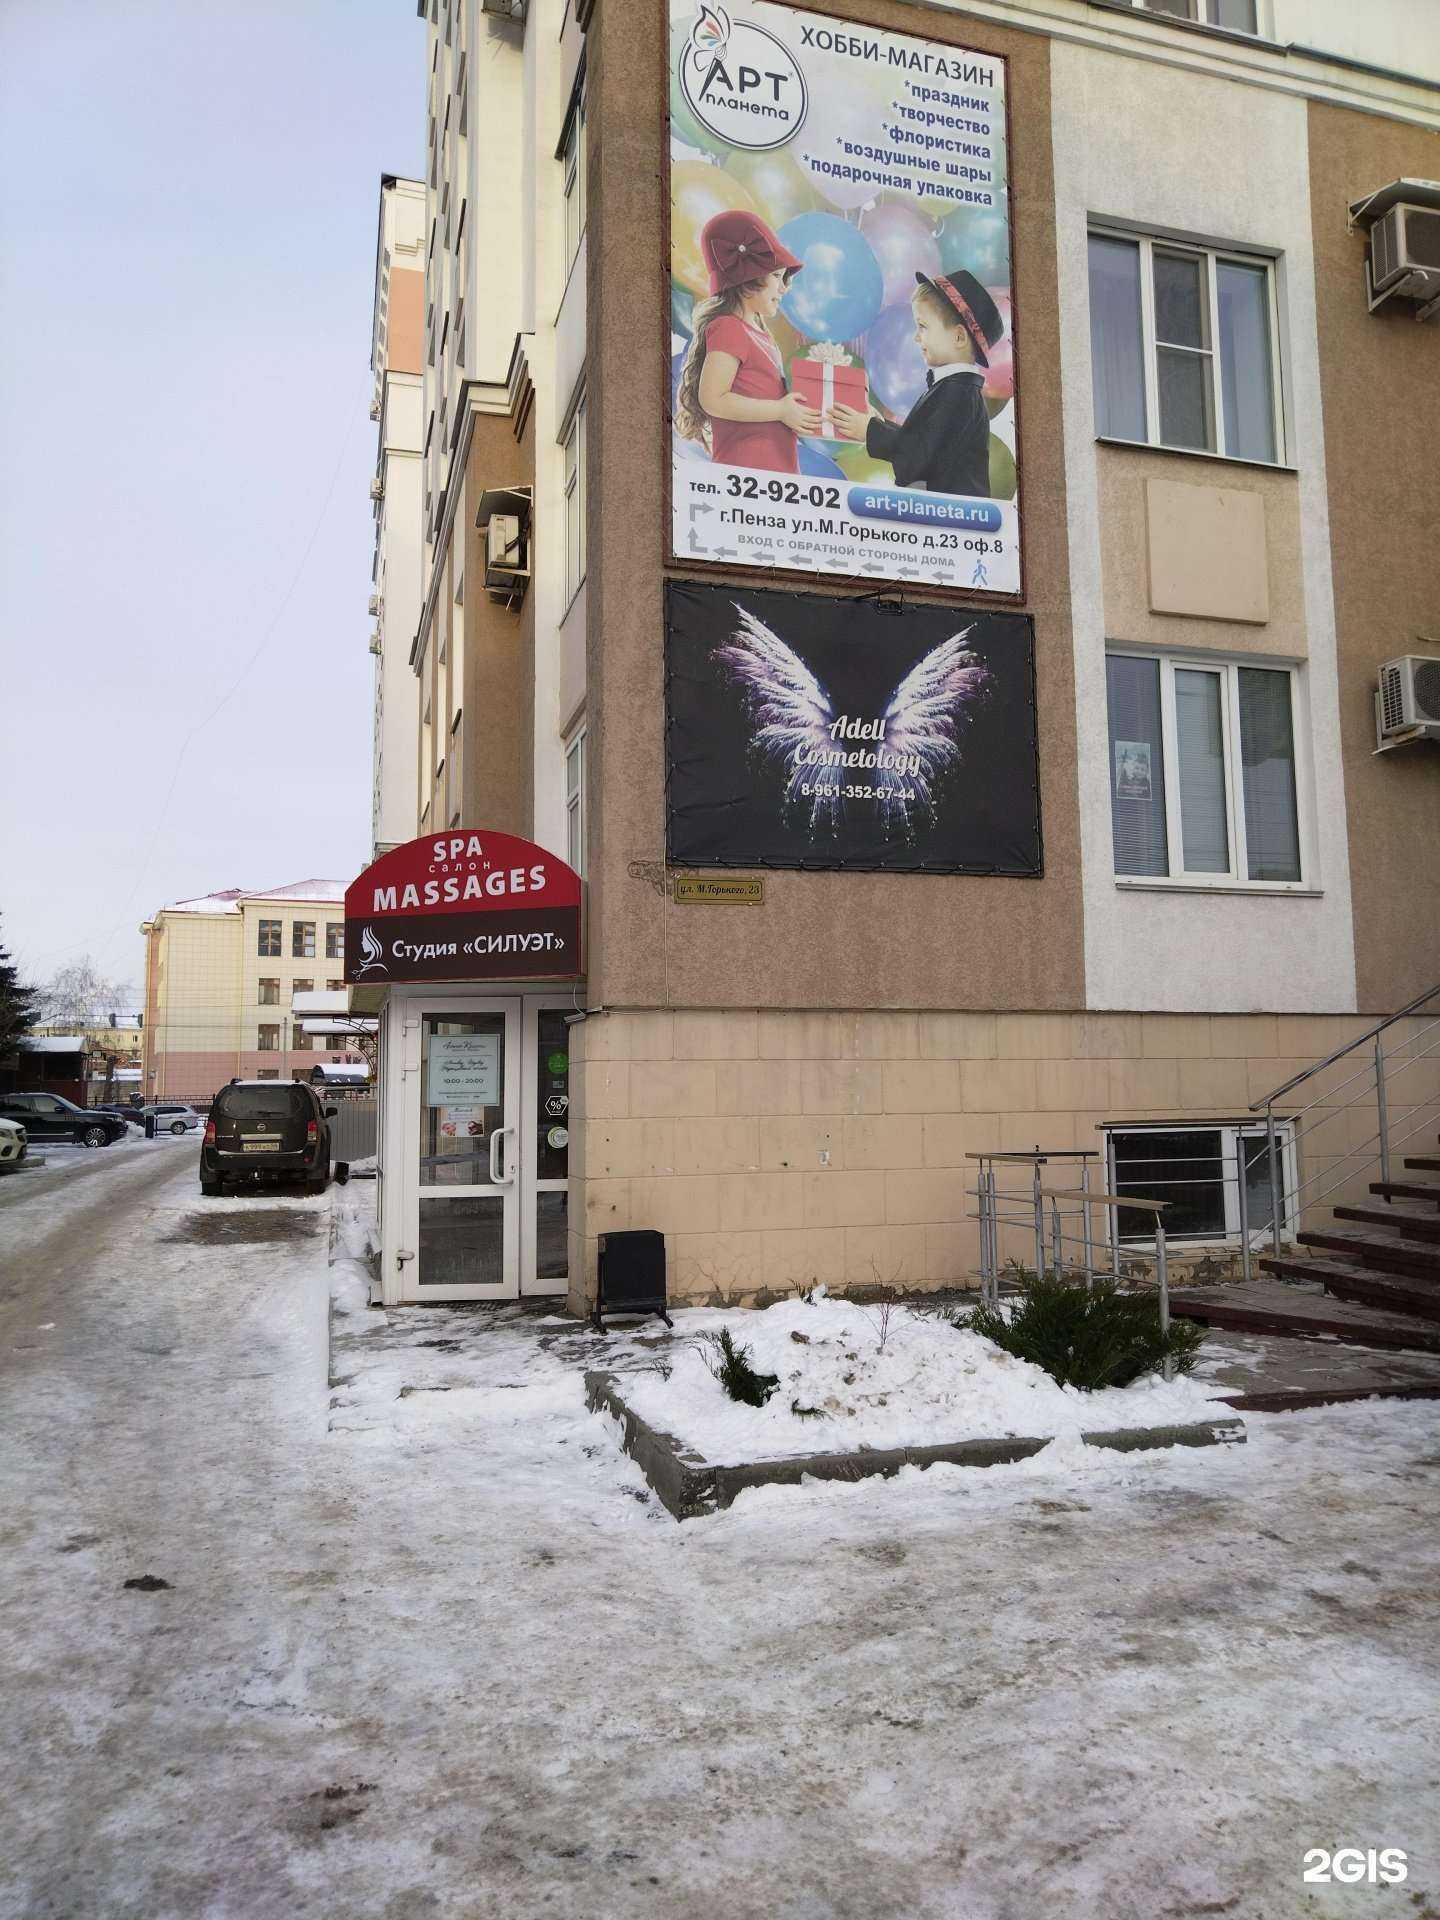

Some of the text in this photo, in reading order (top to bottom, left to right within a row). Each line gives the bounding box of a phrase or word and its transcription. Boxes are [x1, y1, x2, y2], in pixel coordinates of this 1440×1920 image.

[801, 25, 994, 88] ХОББИ-МАГАЗИН
[699, 57, 788, 101] АРТ
[705, 93, 789, 121] планета
[945, 160, 992, 182] шары
[916, 179, 992, 206] упаковка
[689, 474, 841, 509] тел. 32-92-02
[864, 493, 990, 523] art-planeta.ru
[720, 508, 1003, 555] г.Пенза ул.М.Горького д.23 оф.8
[737, 534, 956, 567] ВХОД С ОБРАТНОЙ СТОРОНЫ ДОМА
[829, 715, 886, 741] Adell
[794, 743, 921, 777] Cosmetology
[801, 783, 916, 801] 8-961-352-67-44
[433, 836, 483, 863] SPA
[428, 861, 491, 873] салон
[373, 865, 546, 912] MASSAGES
[680, 885, 694, 895] ул.
[748, 885, 760, 895] 23
[392, 932, 565, 962] Студия «СИЛУЭТ»
